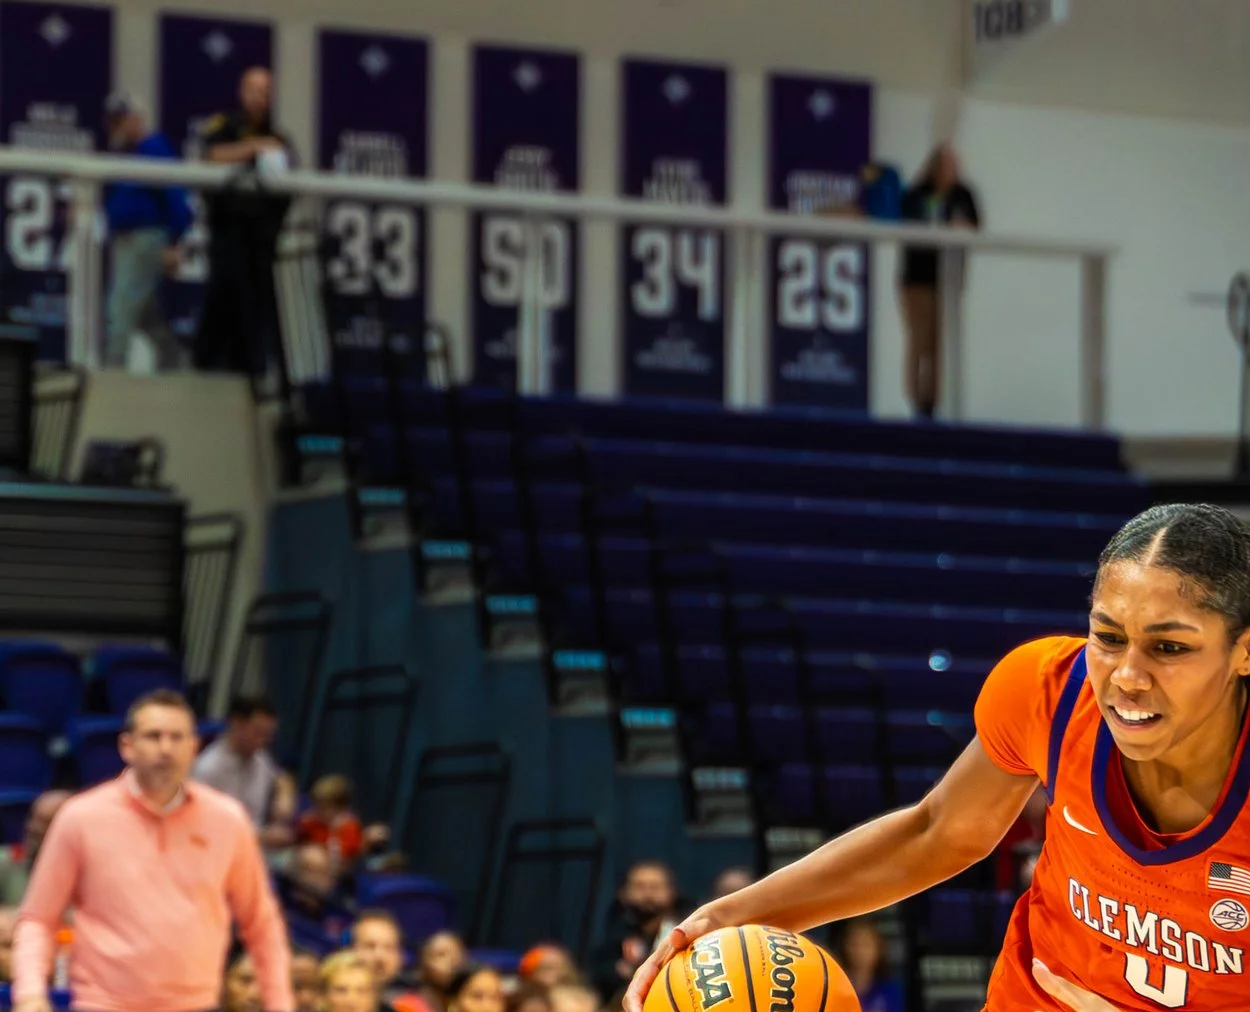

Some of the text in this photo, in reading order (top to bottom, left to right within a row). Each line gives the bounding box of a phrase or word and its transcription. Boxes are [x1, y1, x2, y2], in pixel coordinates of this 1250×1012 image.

[329, 204, 418, 298] 33
[631, 228, 717, 320] 34
[778, 242, 862, 332] 25
[1068, 876, 1244, 975] CLEMSON
[1218, 910, 1246, 922] ACC
